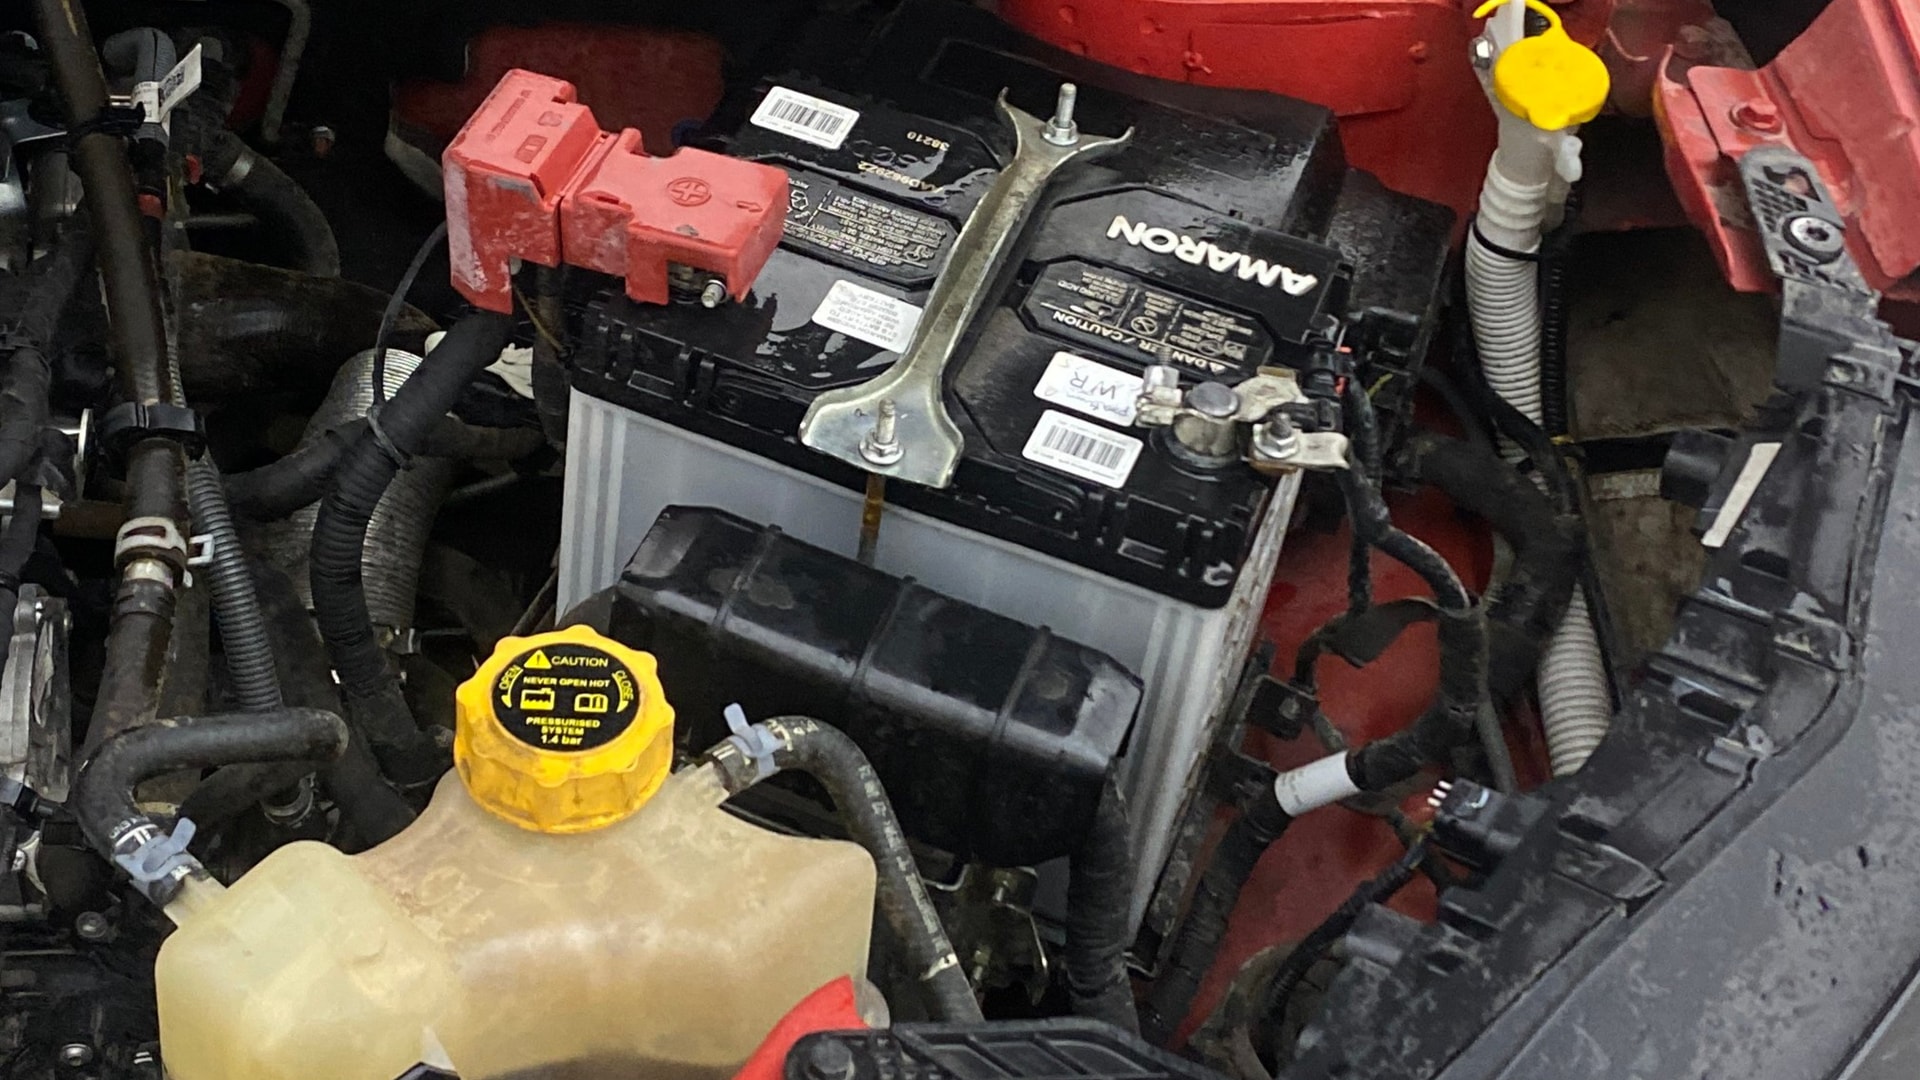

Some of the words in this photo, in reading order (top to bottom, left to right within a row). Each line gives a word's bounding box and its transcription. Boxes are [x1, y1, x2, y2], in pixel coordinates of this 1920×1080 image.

[1106, 216, 1317, 296] AMARON
[1137, 339, 1207, 368] DANER
[551, 656, 609, 667] CAUTION
[499, 664, 522, 690] OPEN
[523, 677, 557, 685] NEVER
[560, 678, 587, 687] OPEN
[589, 679, 610, 687] HOT
[615, 670, 634, 701] CLOSE
[526, 717, 601, 728] PRESSURISED
[541, 726, 584, 736] SYSTEM
[541, 735, 558, 744] 1.4
[561, 736, 582, 745] bar
